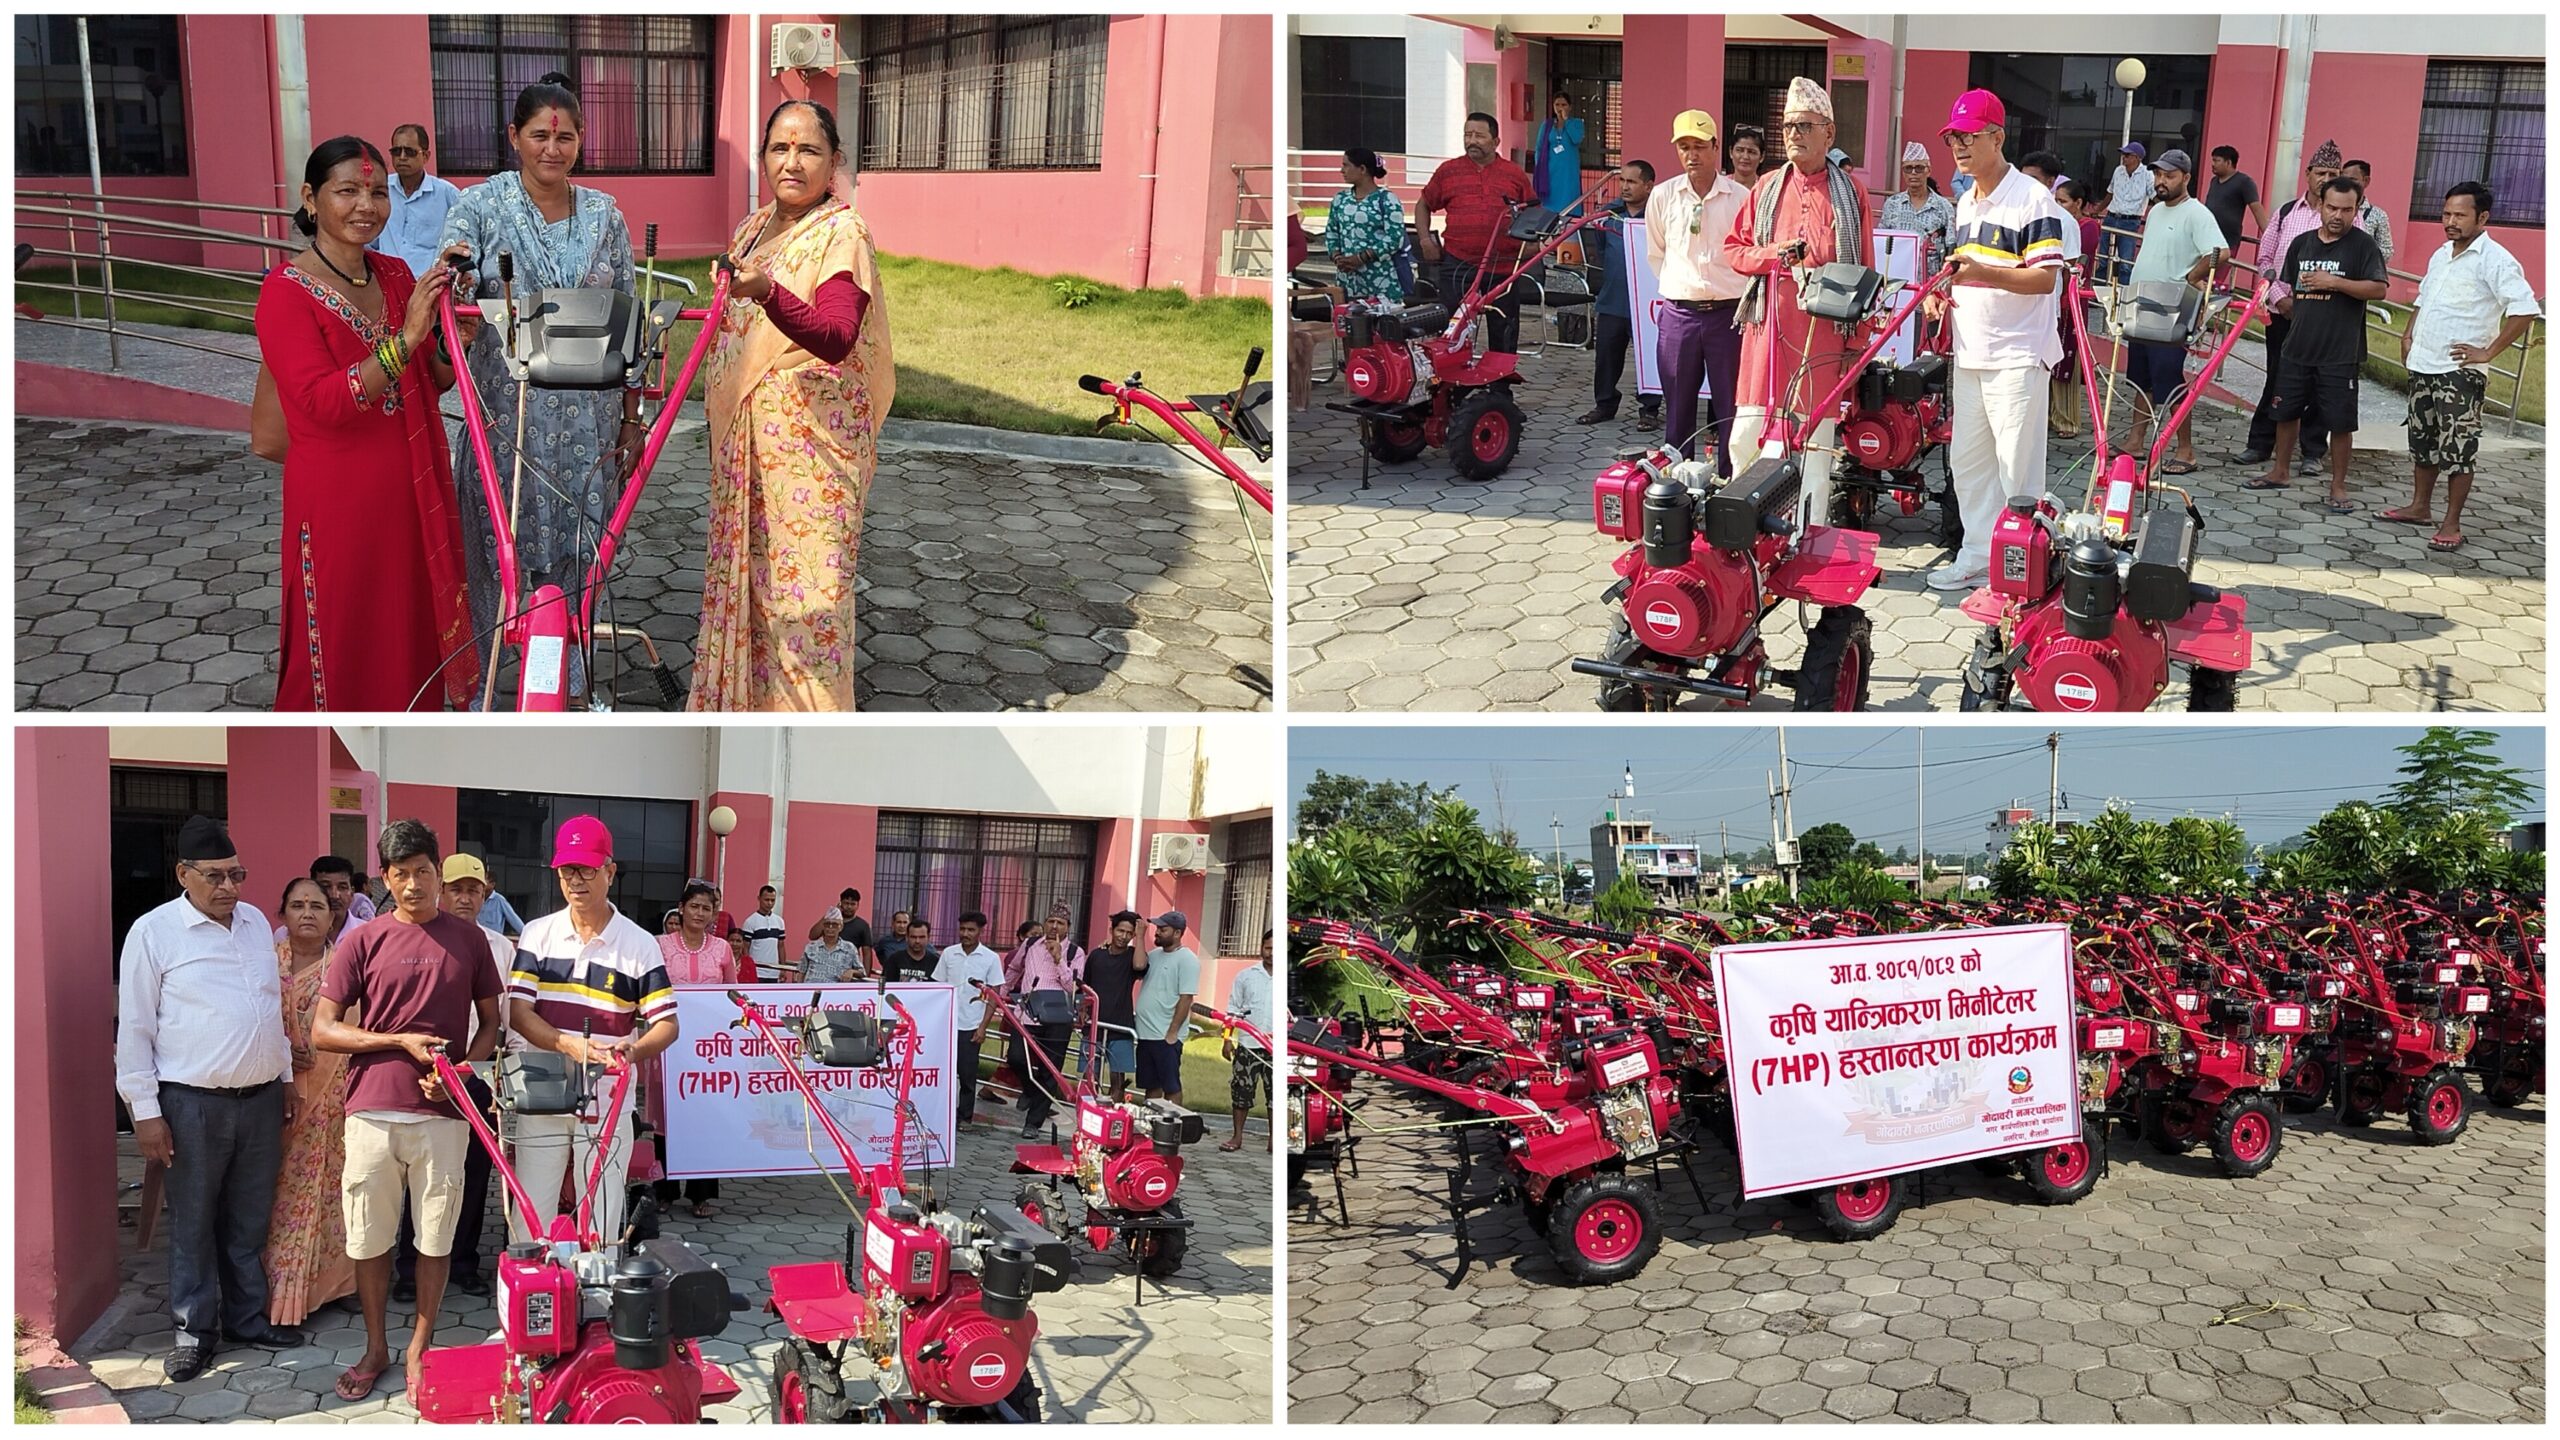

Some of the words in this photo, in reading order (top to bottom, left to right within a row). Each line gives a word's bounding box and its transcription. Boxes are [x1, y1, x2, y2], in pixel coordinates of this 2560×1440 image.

[1655, 615, 1673, 623] 178F
[2066, 688, 2088, 697] 178F
[1829, 961, 1871, 985] आ.व.
[1876, 956, 1954, 981] २०८१/०८२
[1961, 948, 1982, 973] को
[1769, 1002, 1817, 1045] कृषि
[1948, 985, 2038, 1020] मिनीटेलर
[696, 1032, 733, 1064] कृषि
[1751, 1054, 1830, 1095] (7HP)
[1838, 1037, 1960, 1080] हस्तान्तरण
[1968, 1023, 2058, 1060] कार्यक्रम
[679, 1071, 740, 1100] (7HP)
[980, 1367, 999, 1375] 178F
